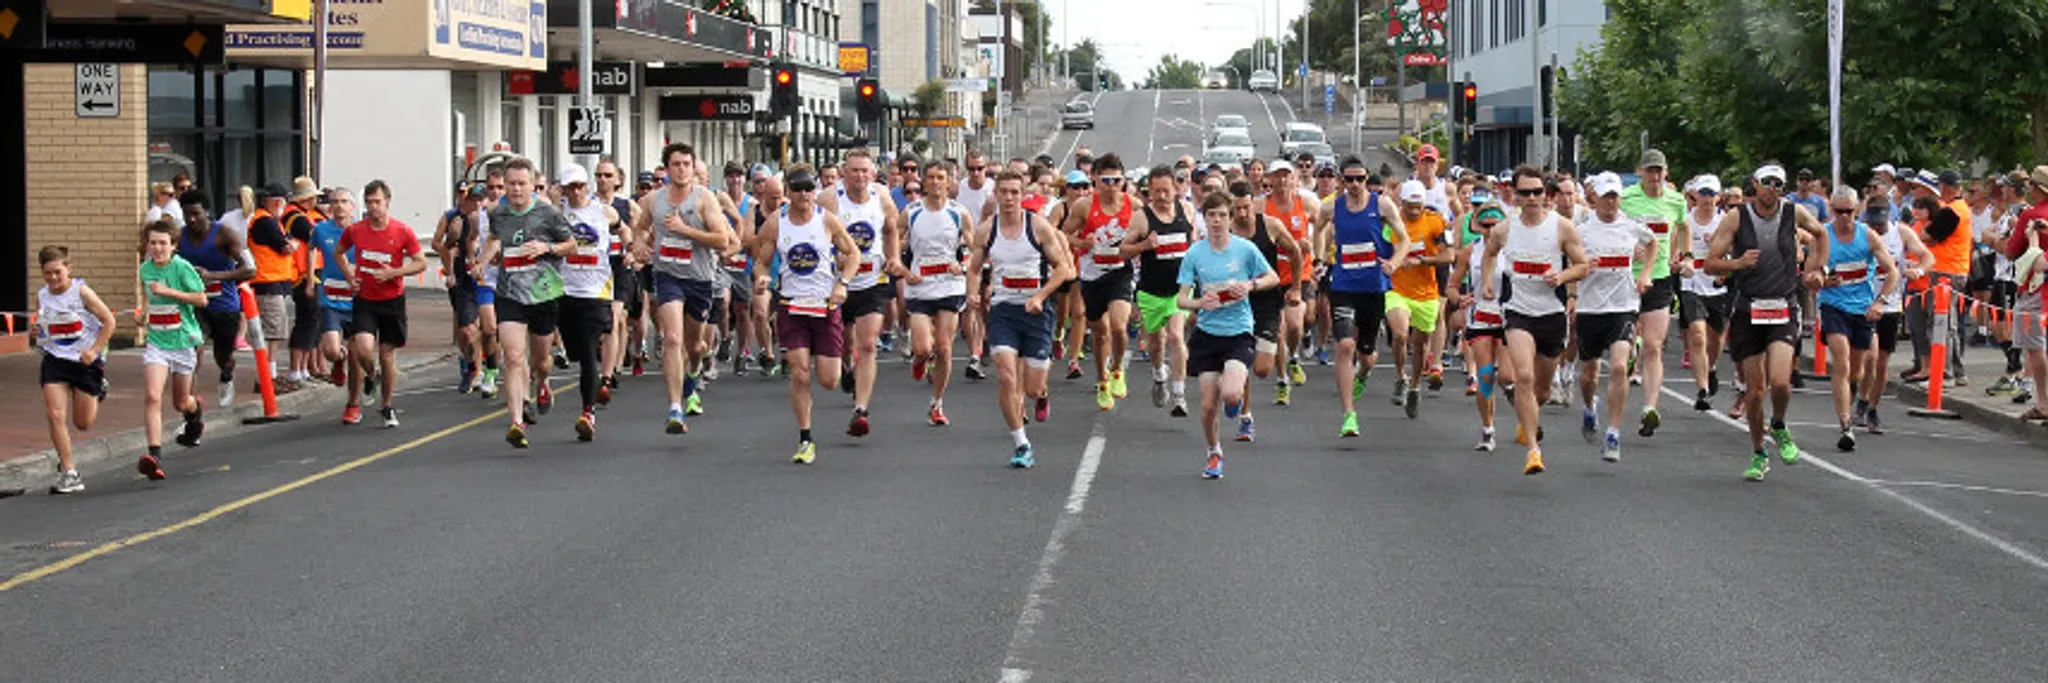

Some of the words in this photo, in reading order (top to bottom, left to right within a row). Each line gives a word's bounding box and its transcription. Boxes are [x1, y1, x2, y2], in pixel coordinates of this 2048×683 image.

[237, 34, 311, 47] Practising
[81, 64, 113, 78] ONE
[592, 67, 628, 86] nab
[80, 82, 114, 95] WAY
[720, 102, 750, 114] nab
